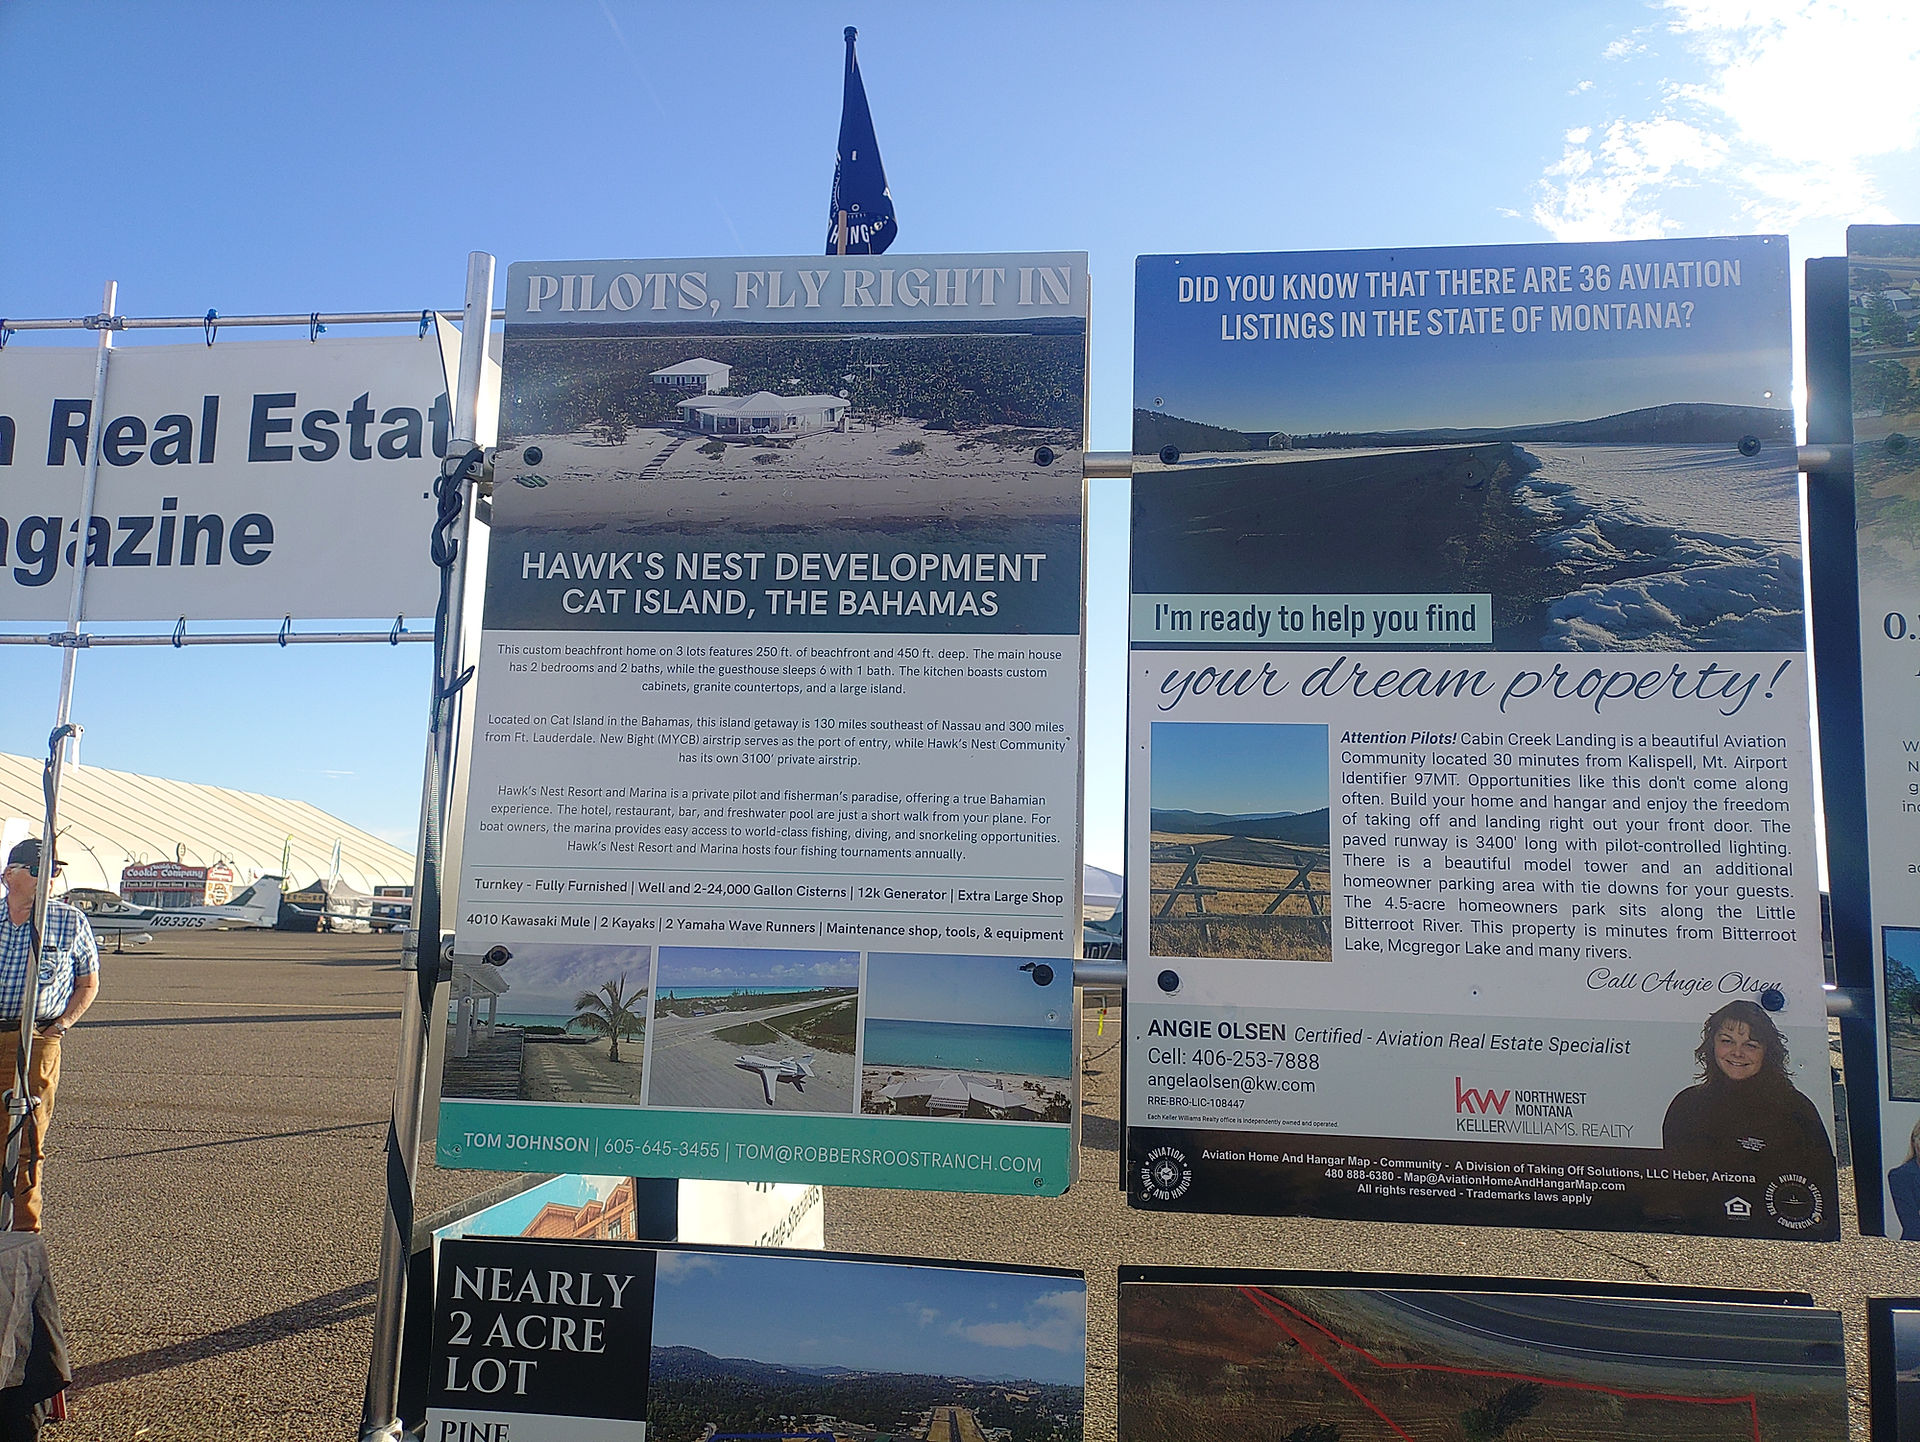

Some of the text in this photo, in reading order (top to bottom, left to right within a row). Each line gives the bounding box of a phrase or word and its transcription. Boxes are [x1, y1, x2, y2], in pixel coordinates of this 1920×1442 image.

[527, 265, 1072, 318] PILOTS, FLY RIGHT IN
[1179, 259, 1741, 302] DID YOU KNOW THAT THERE ARE 36 AVIATION
[1221, 301, 1694, 340] LISTINGS IN THE STATE OF MONTANA?
[47, 395, 220, 466] Real
[522, 551, 1046, 582] HAWK'S NEST DEVELOPMENT
[562, 589, 998, 619] CAT ISLAND, THE BAHAMAS
[1155, 604, 1476, 637] I'm ready to help you find
[642, 681, 689, 693] cabinets,
[693, 682, 730, 694] granite
[734, 683, 802, 695] countertops,
[806, 683, 826, 693] and
[840, 683, 867, 696] large
[871, 684, 905, 694] island.
[1157, 656, 1794, 716] your dream property!
[1341, 731, 1786, 749] Attention Pilots! Cabin Creek Landing is a beautiful Aviation
[475, 879, 1063, 905] Turnkey Fully Furnished Well and 2-24,000 Gallon Cisterns 12k Generator Extra Large Shop
[150, 916, 206, 928] N933CS
[467, 914, 1063, 942] 4010 Kawasaki Mule 2 Kayaks 2 Yamaha Wave Runners Maintenance shop, tools, & equipment
[1586, 967, 1637, 990] Call
[1641, 969, 1713, 996] Angie
[1148, 1020, 1631, 1056] ANGIE OLSEN Certified Aviation Real Estate Specialist
[1148, 1047, 1320, 1070] Cell: 406-253-7888
[1148, 1073, 1315, 1093] angelaolsen@kw.com
[1455, 1076, 1511, 1115] kw
[1515, 1090, 1587, 1105] NORTHWEST
[1147, 1096, 1245, 1109] RRE-BRO-LIC-108447
[1515, 1104, 1573, 1118] MONTANA
[1582, 1123, 1634, 1139] REALTY
[464, 1132, 1041, 1173] TOM JOHNSON 605-645-3455 TOM@ROBBERSROOSTRANCH.COM
[1148, 1147, 1185, 1162] AVIATION
[1202, 1149, 1756, 1183] Aviation Home And Hangar Map Community A Division of Taking Off Solutions, LLC Heber, Arizona
[1141, 1168, 1191, 1200] HOME AND HANGAR
[1325, 1168, 1626, 1192] 480 888-6380 Map@AviationHomeAndHangarMap.com
[1357, 1184, 1592, 1206] All rights reserved Trademarks laws apply
[451, 1265, 636, 1309] NEARLY
[448, 1311, 607, 1354] 2 ACRE
[443, 1356, 538, 1395] LOT
[440, 1420, 510, 1442] PINE
